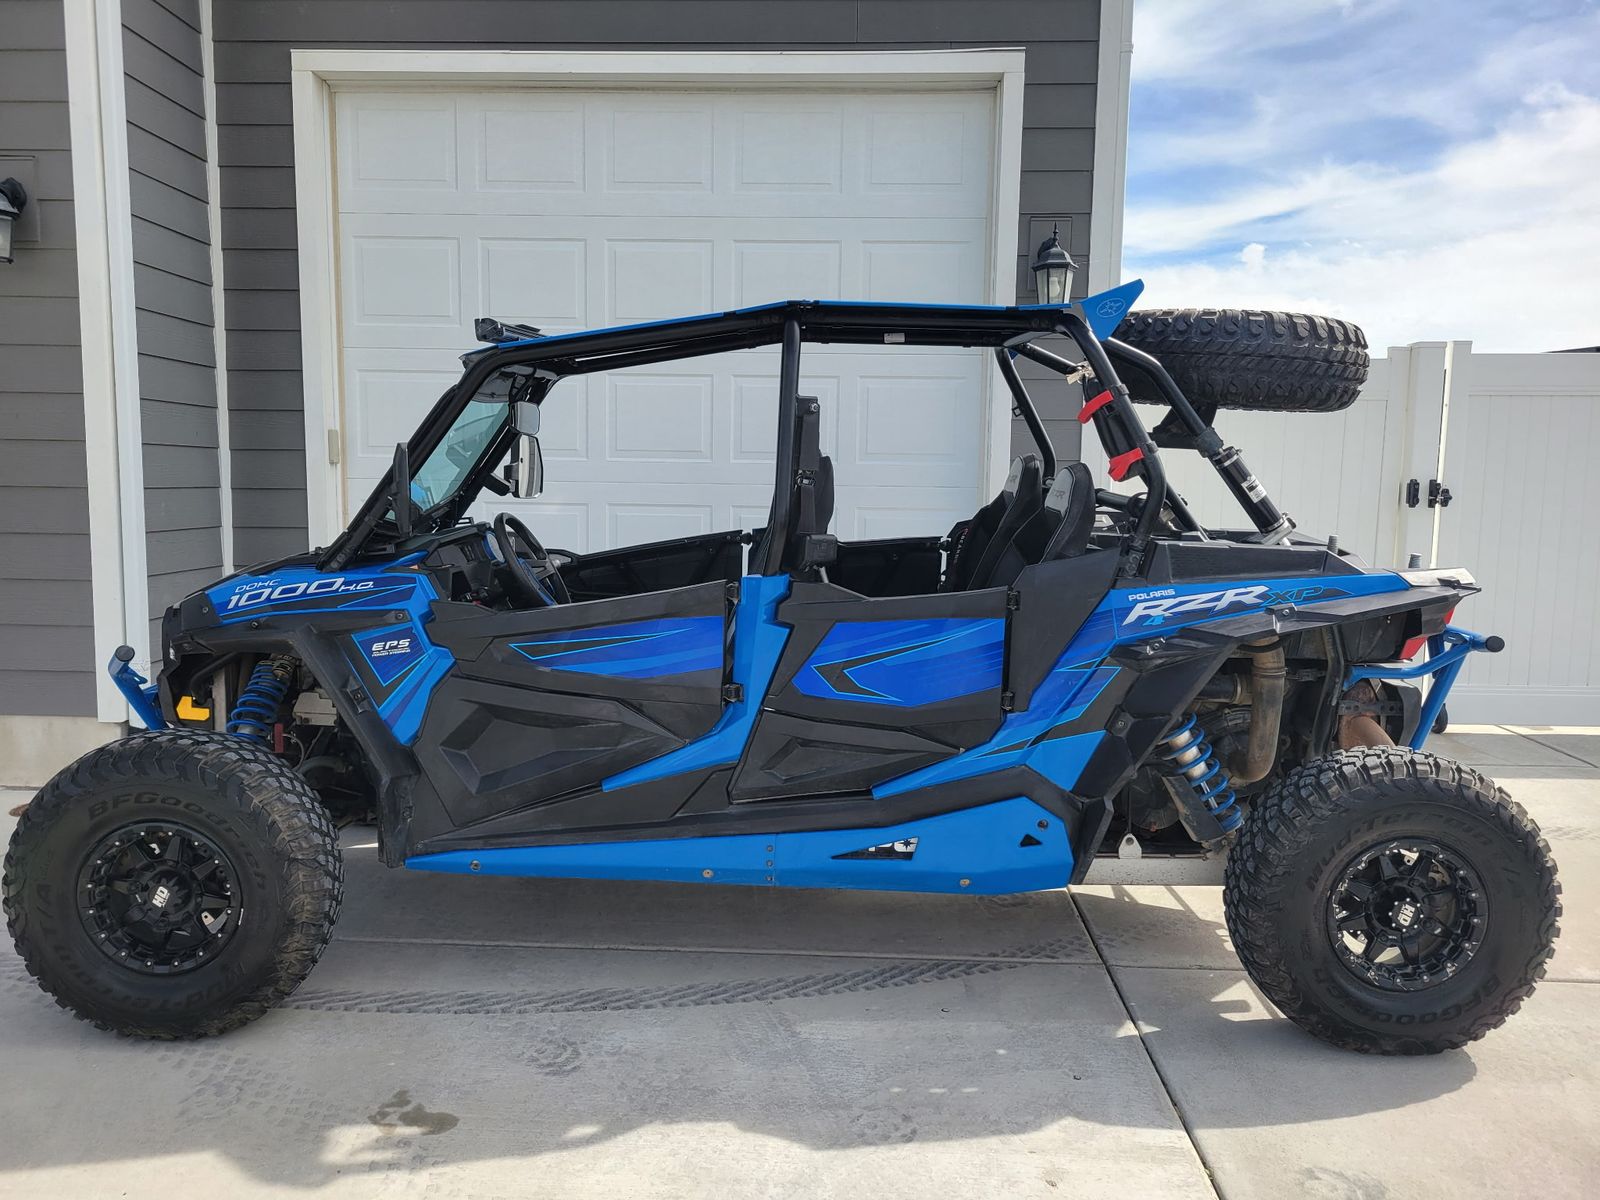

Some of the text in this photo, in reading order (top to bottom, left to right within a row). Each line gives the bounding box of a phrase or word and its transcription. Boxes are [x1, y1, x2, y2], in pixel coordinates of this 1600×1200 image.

[235, 578, 281, 593] DOHC
[227, 577, 345, 609] 1000
[1128, 588, 1176, 602] POLARIS
[1121, 585, 1324, 627] RZR XP
[1142, 613, 1166, 627] 4
[372, 639, 411, 651] EPS
